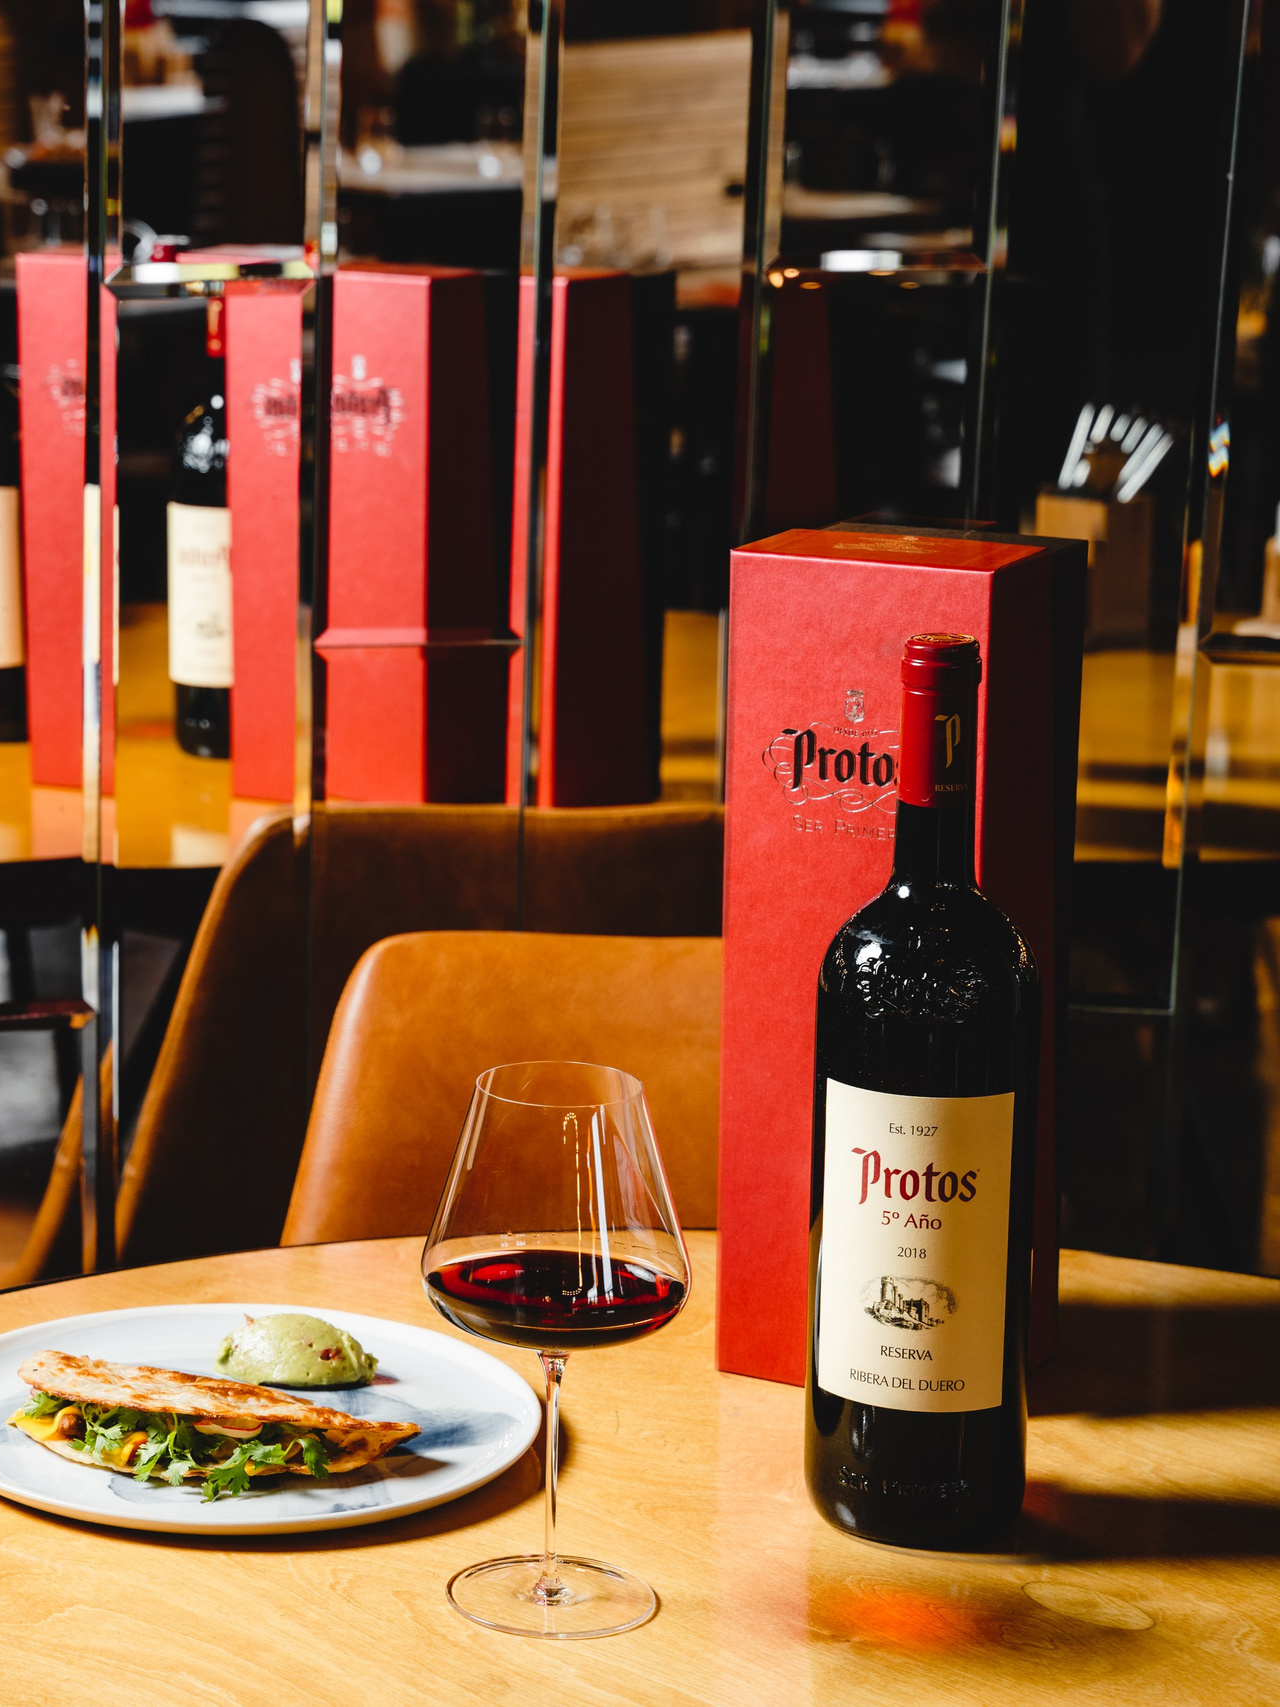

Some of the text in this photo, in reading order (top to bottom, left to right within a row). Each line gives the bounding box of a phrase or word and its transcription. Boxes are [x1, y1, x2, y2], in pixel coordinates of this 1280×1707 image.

[934, 713, 961, 769] P
[781, 728, 899, 791] Proto
[934, 783, 969, 792] RESERVA
[889, 1123, 939, 1137] Est. 1927
[851, 1147, 978, 1205] Protos
[904, 1213, 942, 1230] Año
[897, 1246, 927, 1260] 2018
[880, 1345, 933, 1361] RESERVA
[849, 1368, 966, 1392] RIBERA DEL DUERO
